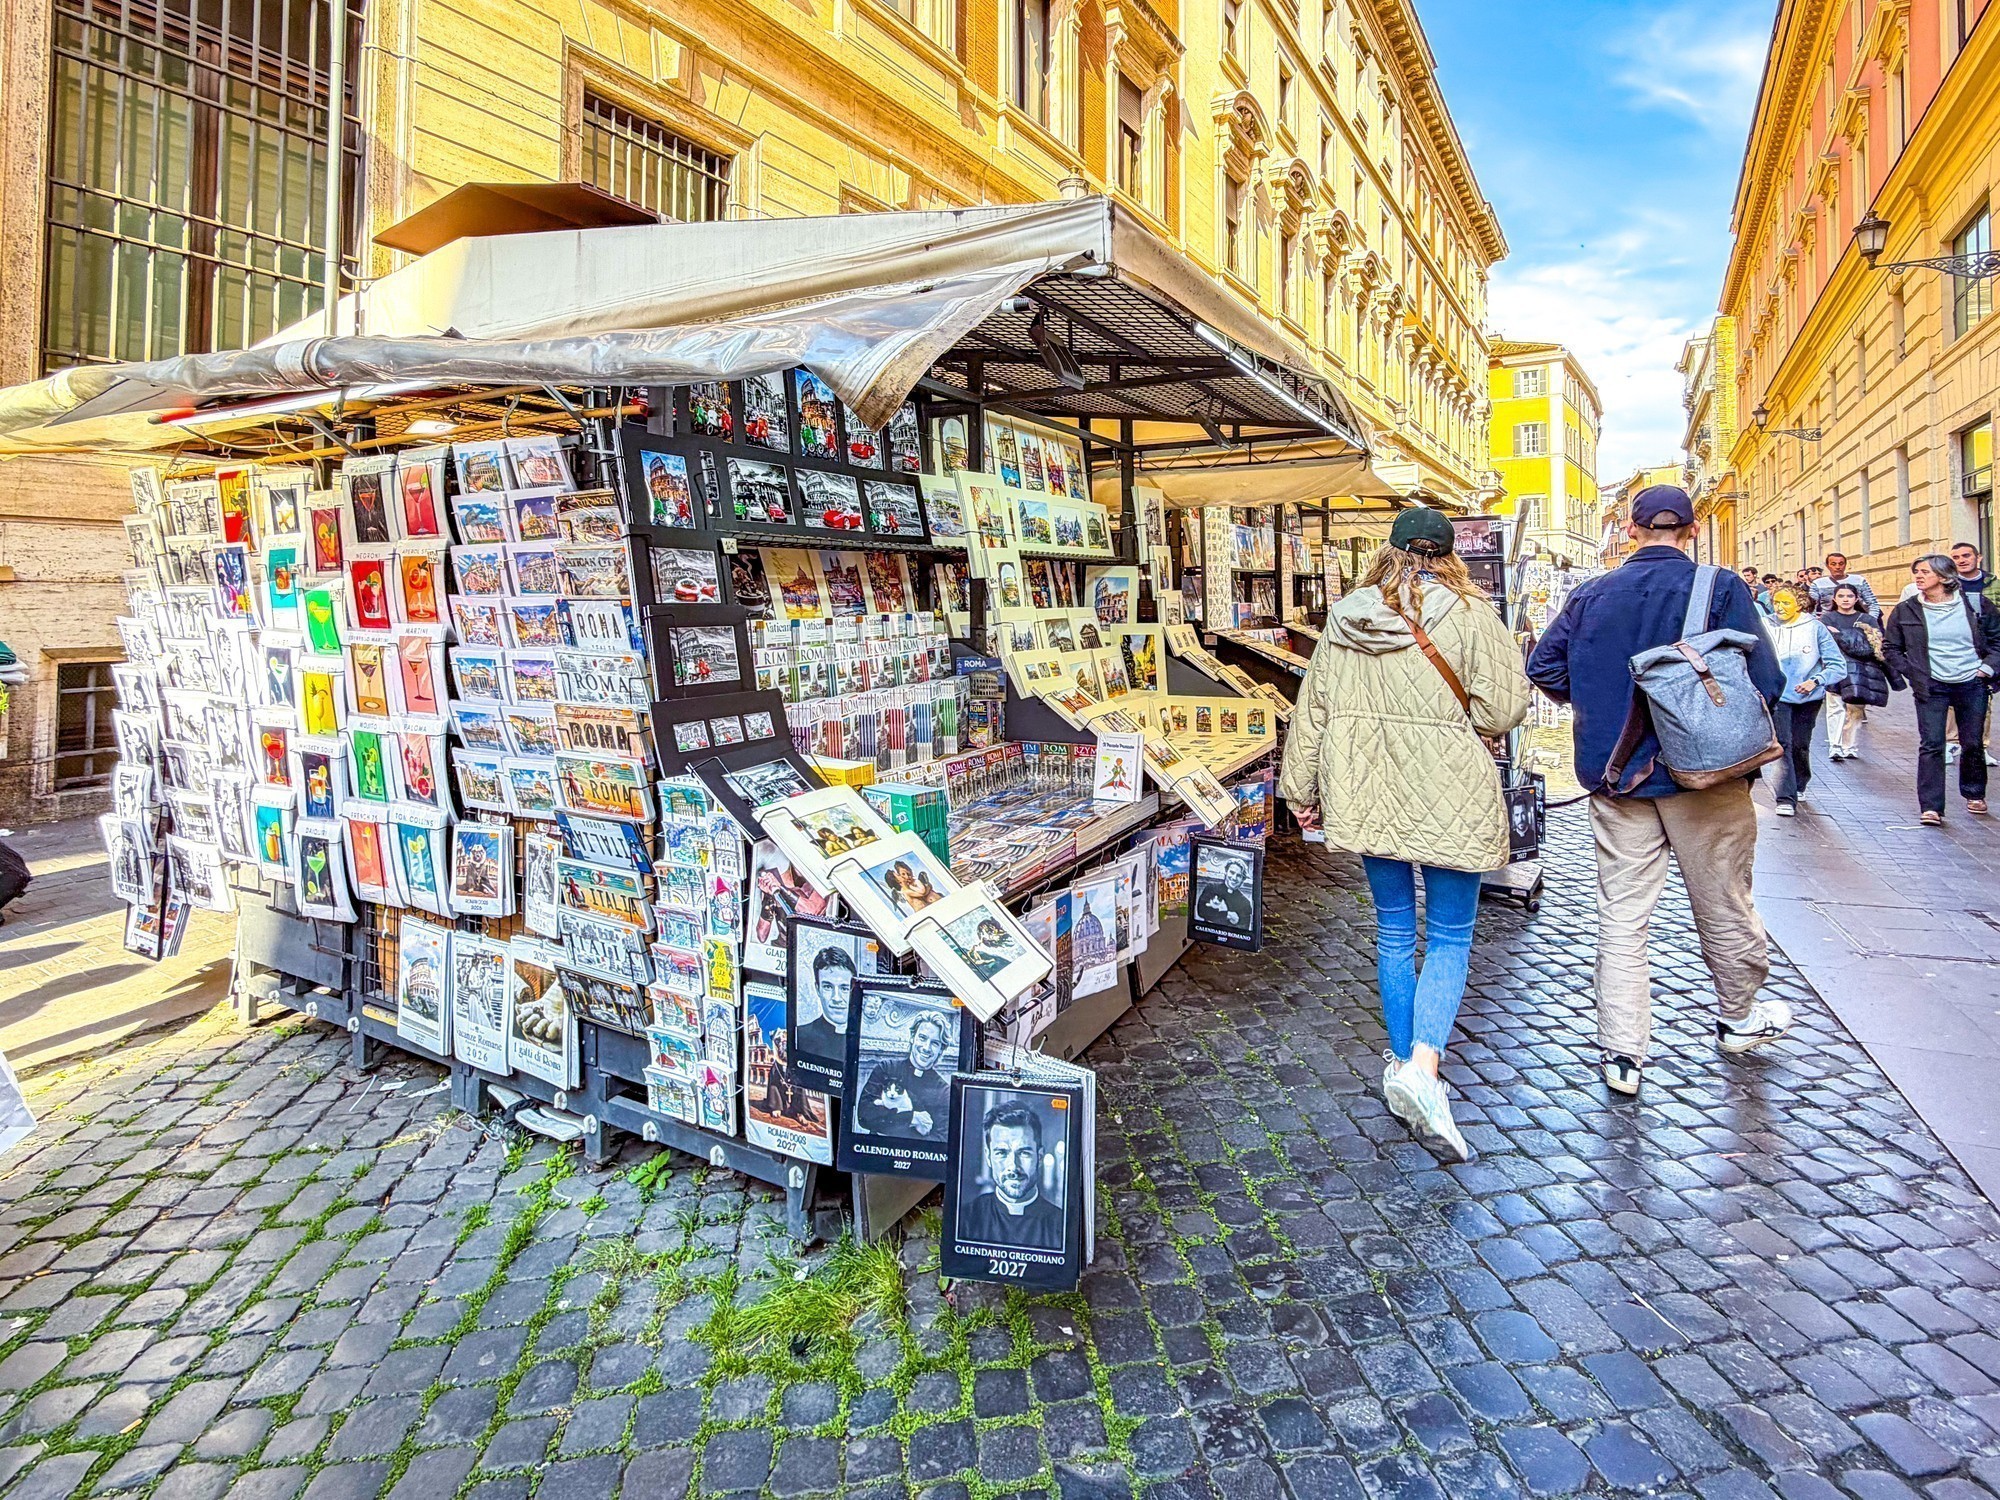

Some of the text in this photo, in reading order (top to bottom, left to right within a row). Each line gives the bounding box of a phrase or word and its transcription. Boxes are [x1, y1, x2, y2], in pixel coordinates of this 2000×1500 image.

[576, 613, 622, 639] ROMA
[964, 660, 987, 668] ROMA
[573, 673, 630, 694] ROMA
[569, 722, 630, 751] ROMA
[1043, 743, 1067, 752] ROM
[948, 763, 966, 773] ROME
[590, 780, 631, 803] ROMA
[409, 816, 434, 827] COLLINS
[589, 887, 639, 916] ITALIA
[467, 1046, 489, 1062] 2026
[797, 1060, 843, 1078] CALENDARIO
[828, 1079, 843, 1088] 2027
[767, 1126, 807, 1145] ROMAN DOGS
[776, 1138, 797, 1152] 2027
[853, 1144, 948, 1162] CALENDARIO ROMAN
[893, 1161, 912, 1169] 2027
[954, 1245, 1066, 1265] CALENDARIO GREGORIANO
[988, 1259, 1028, 1278] 2027
